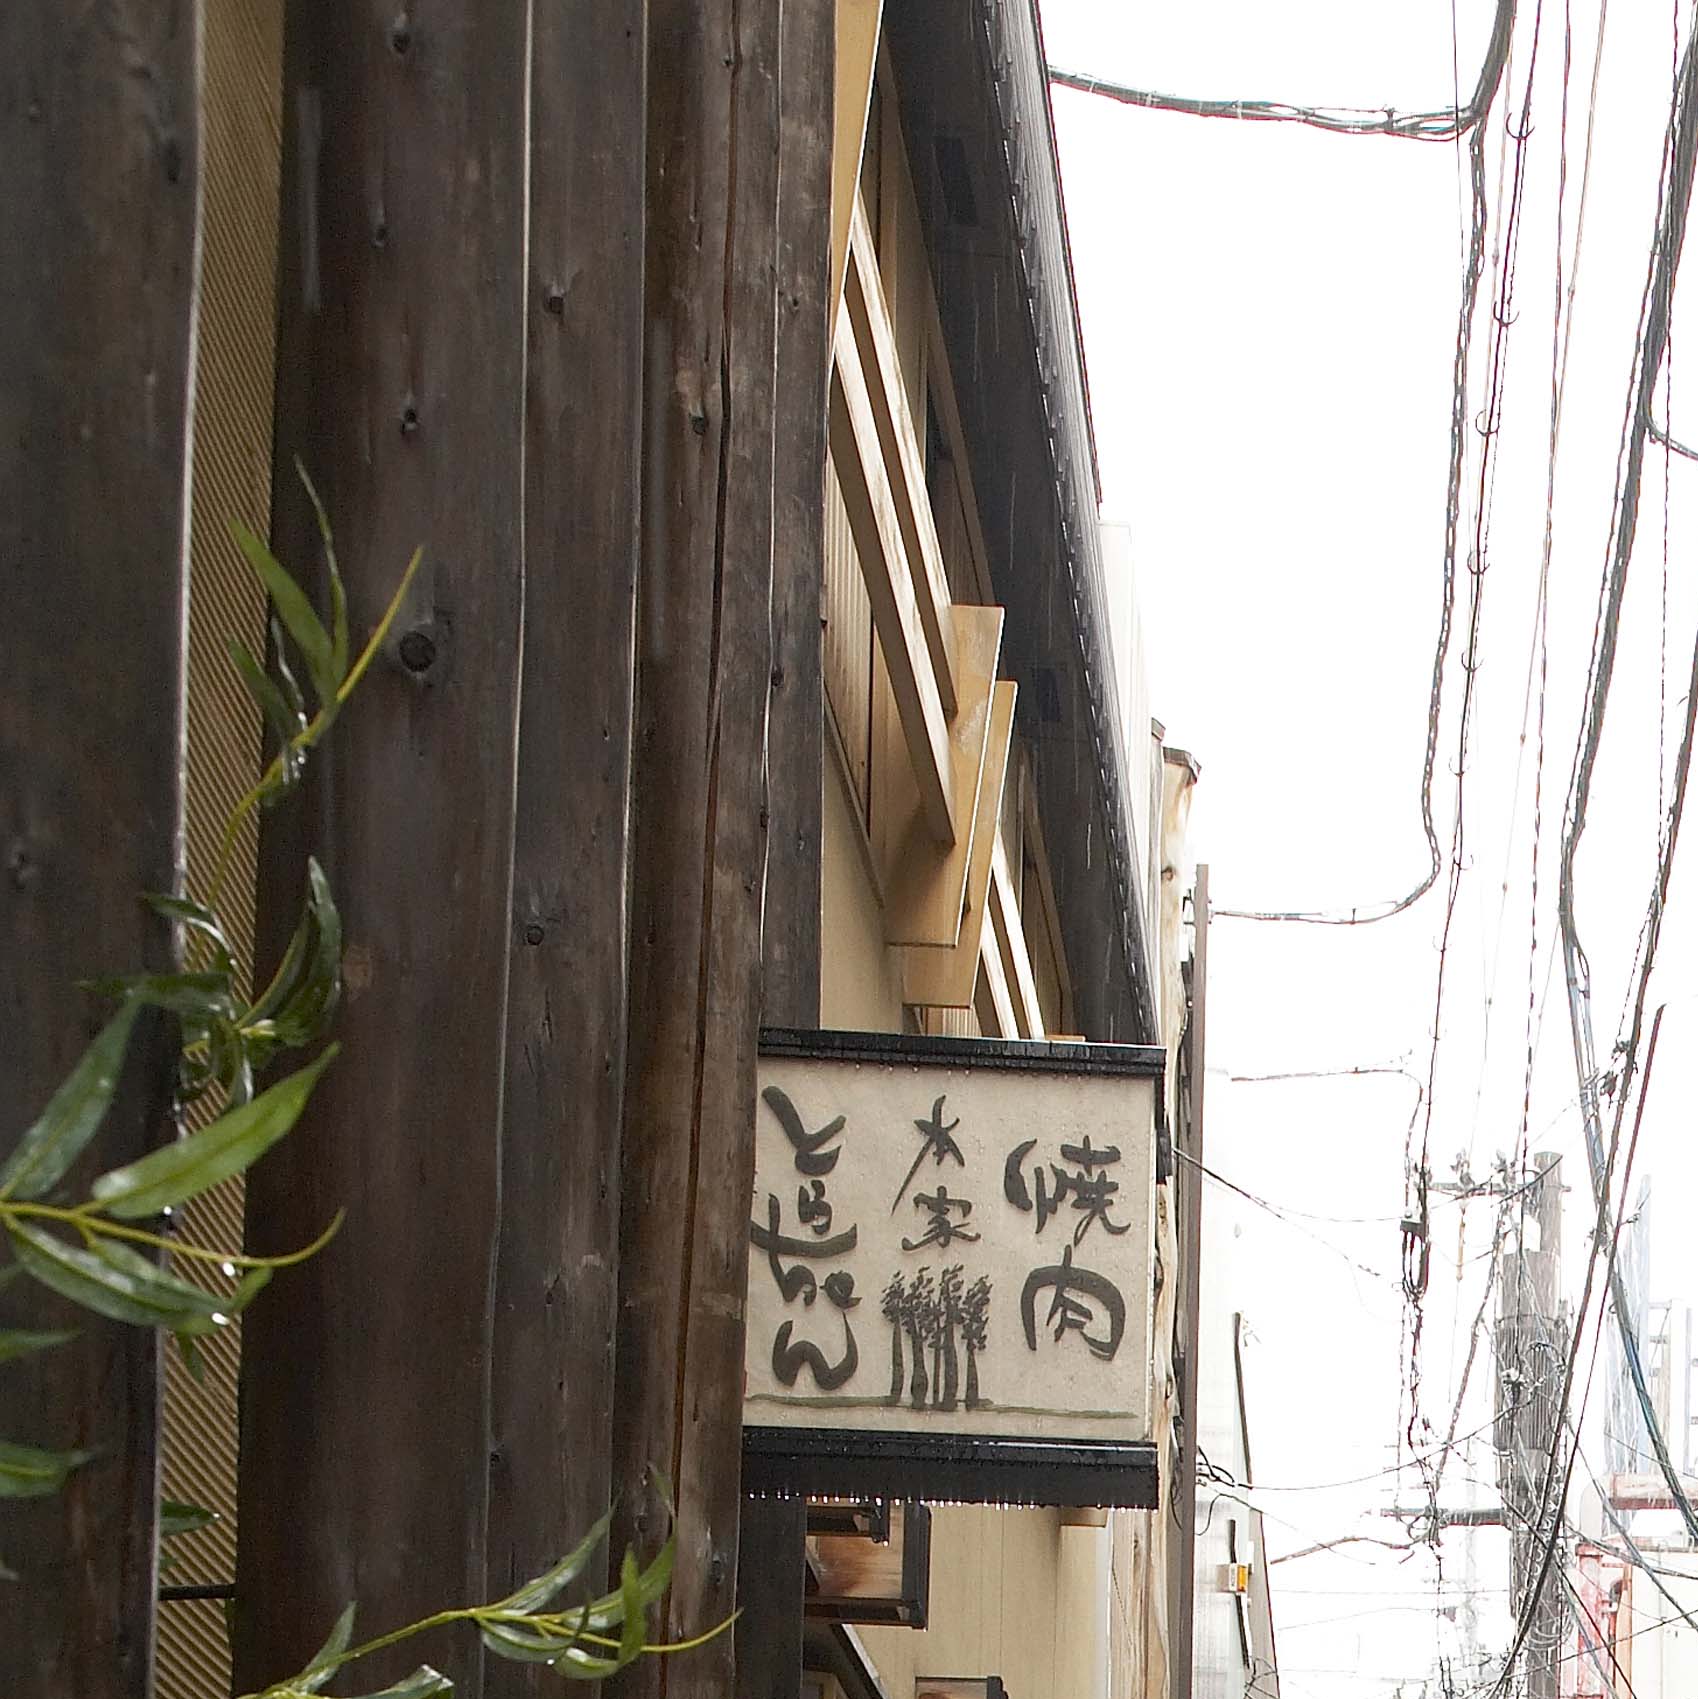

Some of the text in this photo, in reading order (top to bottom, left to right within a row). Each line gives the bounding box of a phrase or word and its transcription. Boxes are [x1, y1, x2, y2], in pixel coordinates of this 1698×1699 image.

[751, 1085, 862, 1390] とらちゃん
[1003, 1135, 1131, 1362] 焼肉
